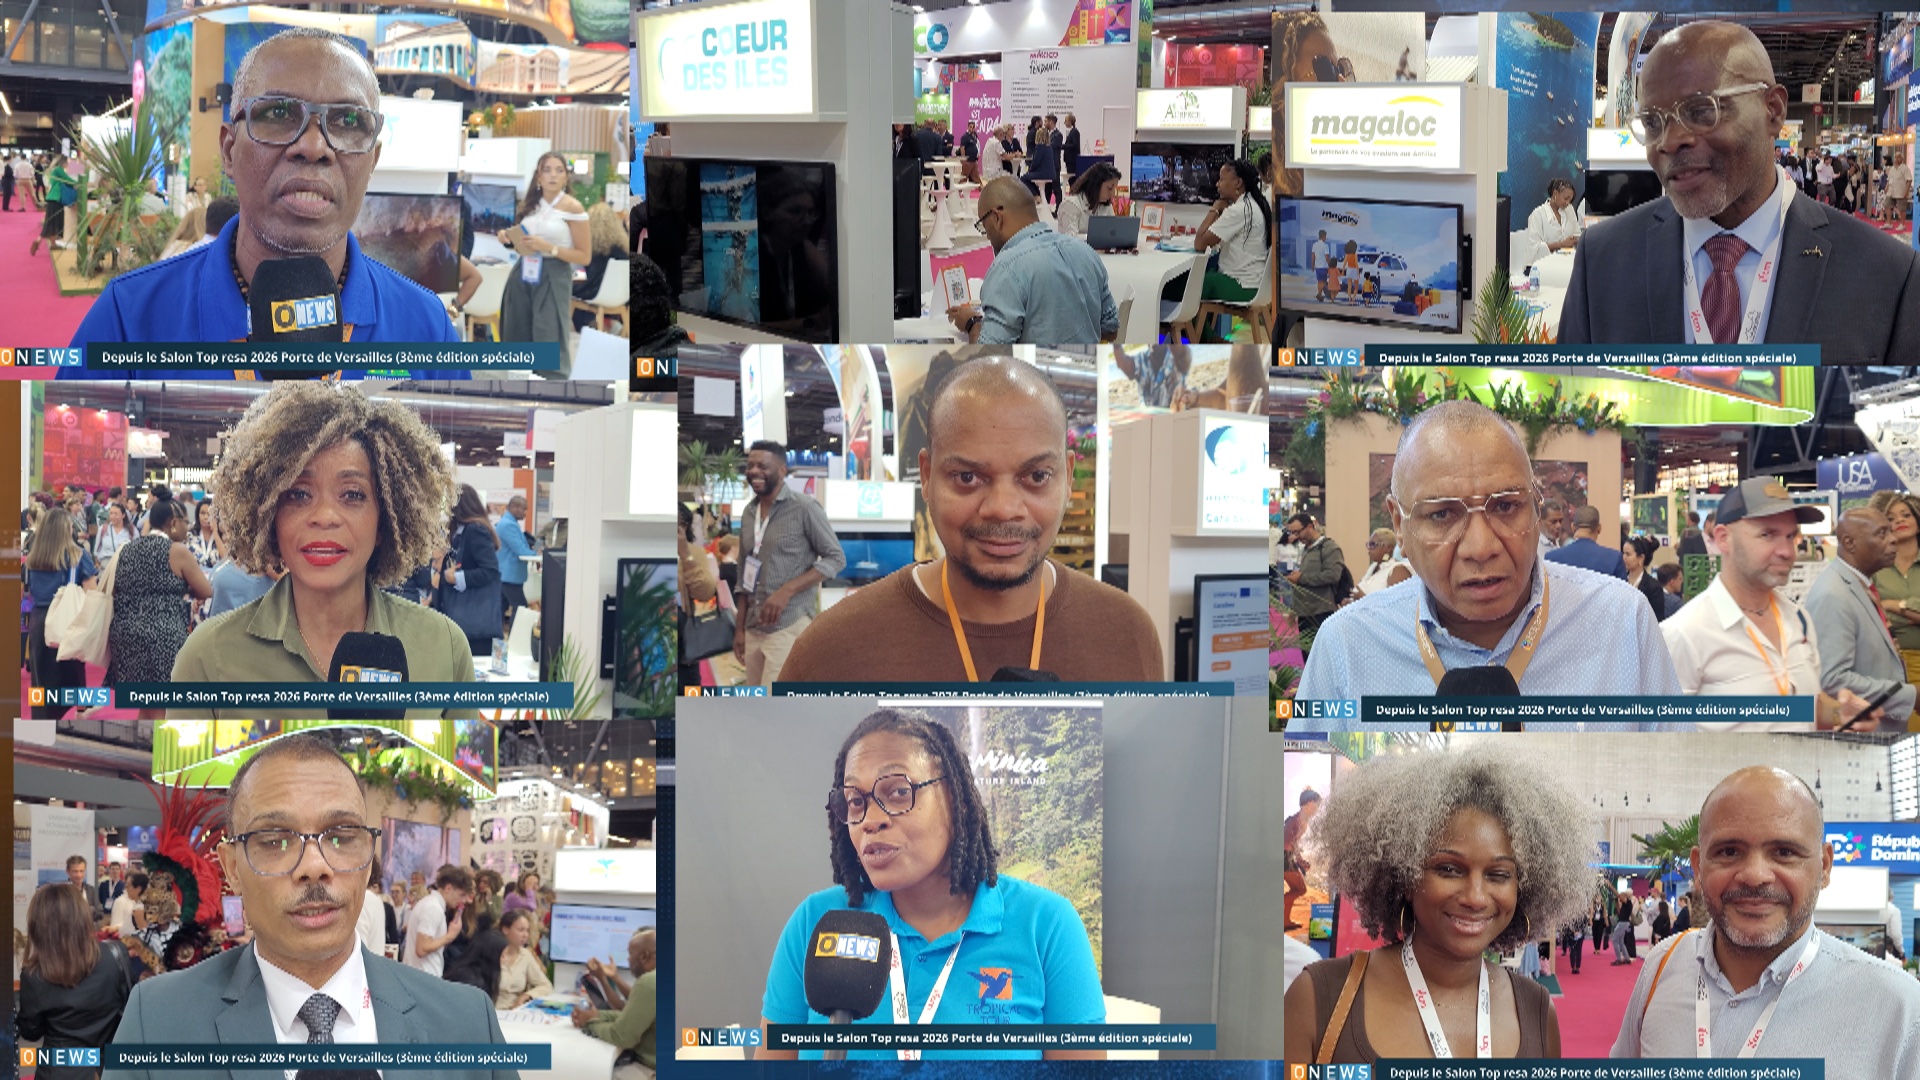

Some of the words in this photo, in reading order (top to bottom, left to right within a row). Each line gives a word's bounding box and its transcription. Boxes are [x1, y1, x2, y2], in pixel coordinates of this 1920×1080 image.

[702, 19, 788, 56] COEUR
[683, 61, 728, 91] DES
[735, 56, 788, 88] ILES
[1311, 109, 1437, 142] magaloc
[273, 299, 334, 329] ONEWS
[1838, 460, 1874, 485] USA
[818, 934, 878, 958] ONEWS
[980, 1015, 1011, 1024] TOUR
